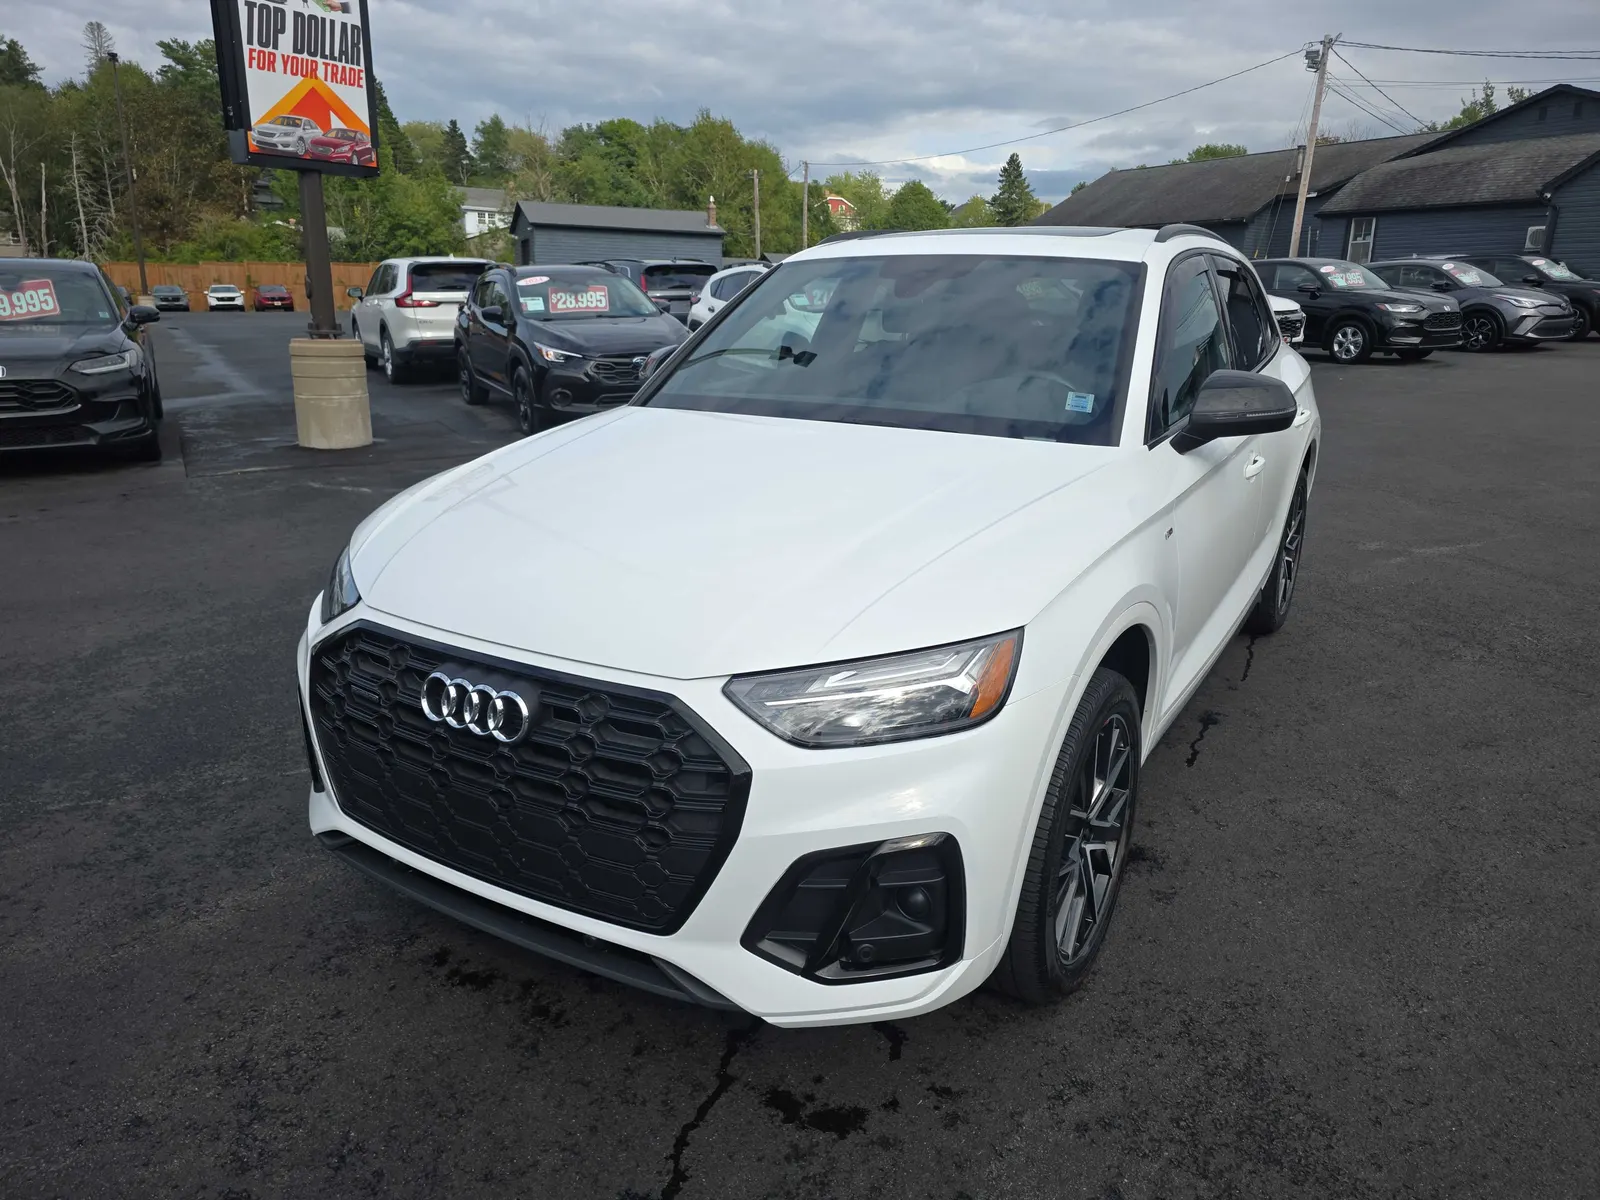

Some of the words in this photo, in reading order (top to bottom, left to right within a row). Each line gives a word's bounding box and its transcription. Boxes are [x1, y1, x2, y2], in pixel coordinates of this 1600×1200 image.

[244, 3, 286, 50] TOP
[292, 11, 362, 66] DOLLAR
[248, 48, 277, 73] FOR
[281, 53, 319, 80] YOUR
[322, 62, 364, 88] TRADE
